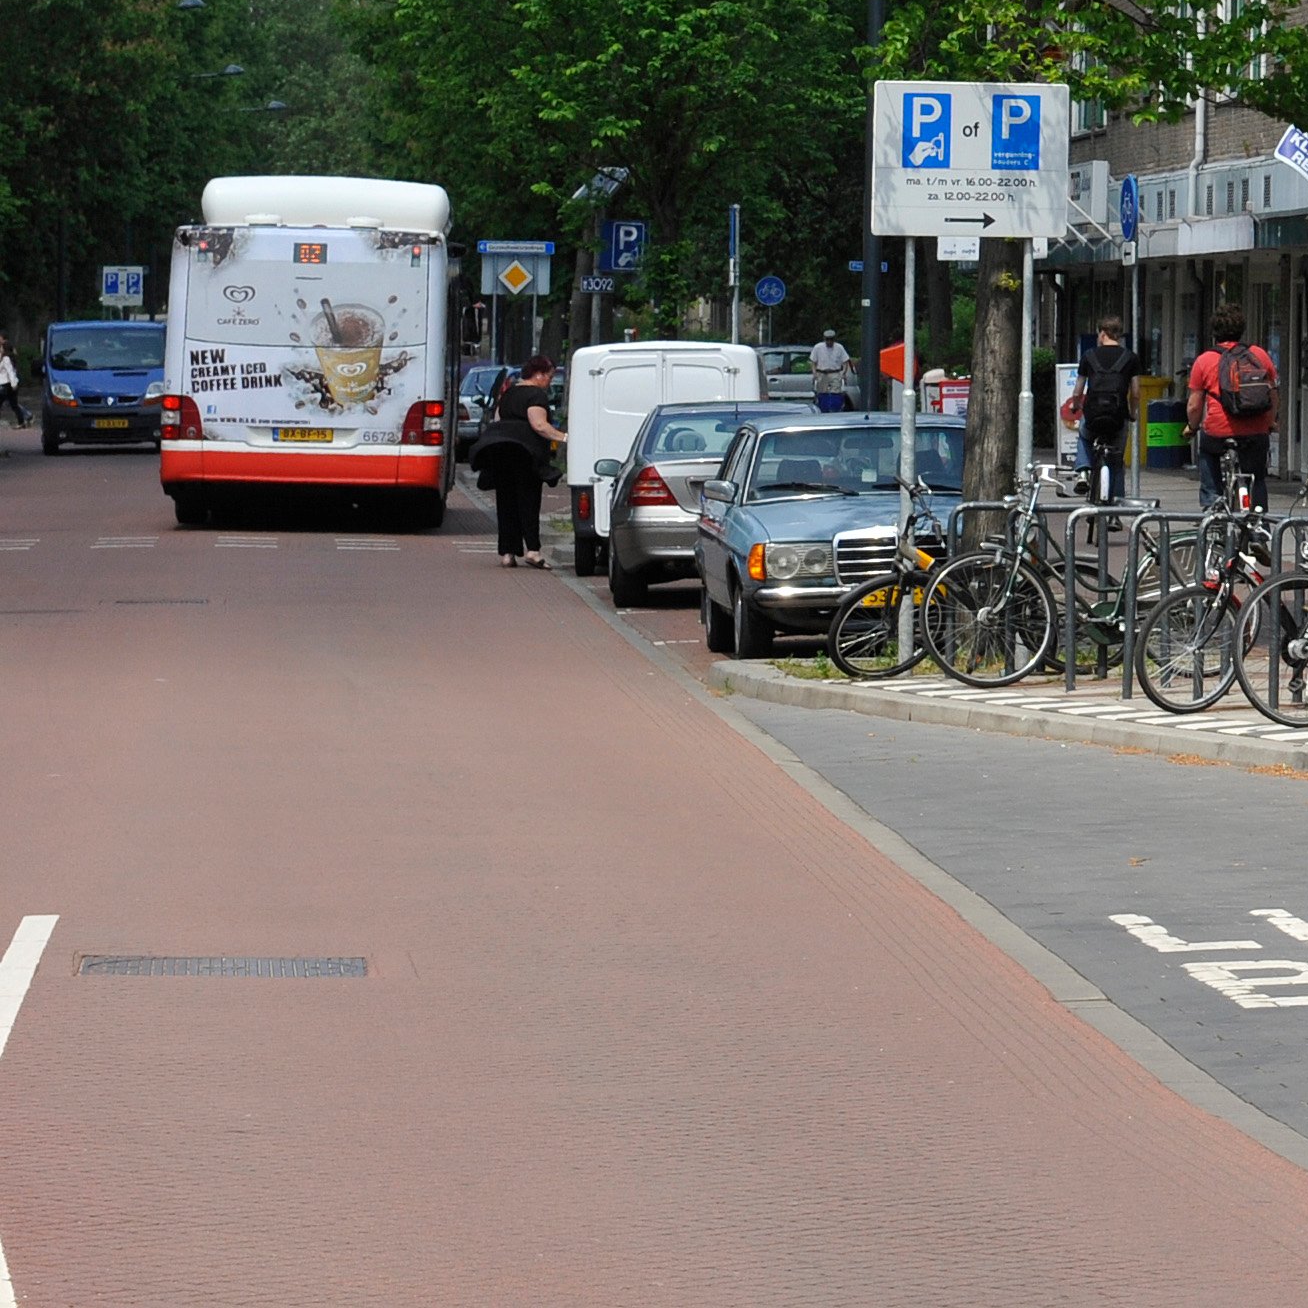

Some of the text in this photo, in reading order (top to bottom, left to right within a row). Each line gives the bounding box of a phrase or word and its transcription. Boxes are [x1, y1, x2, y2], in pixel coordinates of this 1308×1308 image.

[962, 121, 980, 137] of
[927, 178, 947, 186] t/m
[966, 178, 1028, 187] 16.00-22.00
[944, 192, 1005, 201] 12.00-22.00
[588, 278, 613, 291] 3092
[190, 349, 225, 366] NEW
[191, 363, 267, 379] CREAMY ICED
[191, 375, 283, 393] COFFEE DRINK
[363, 431, 394, 442] 6672
